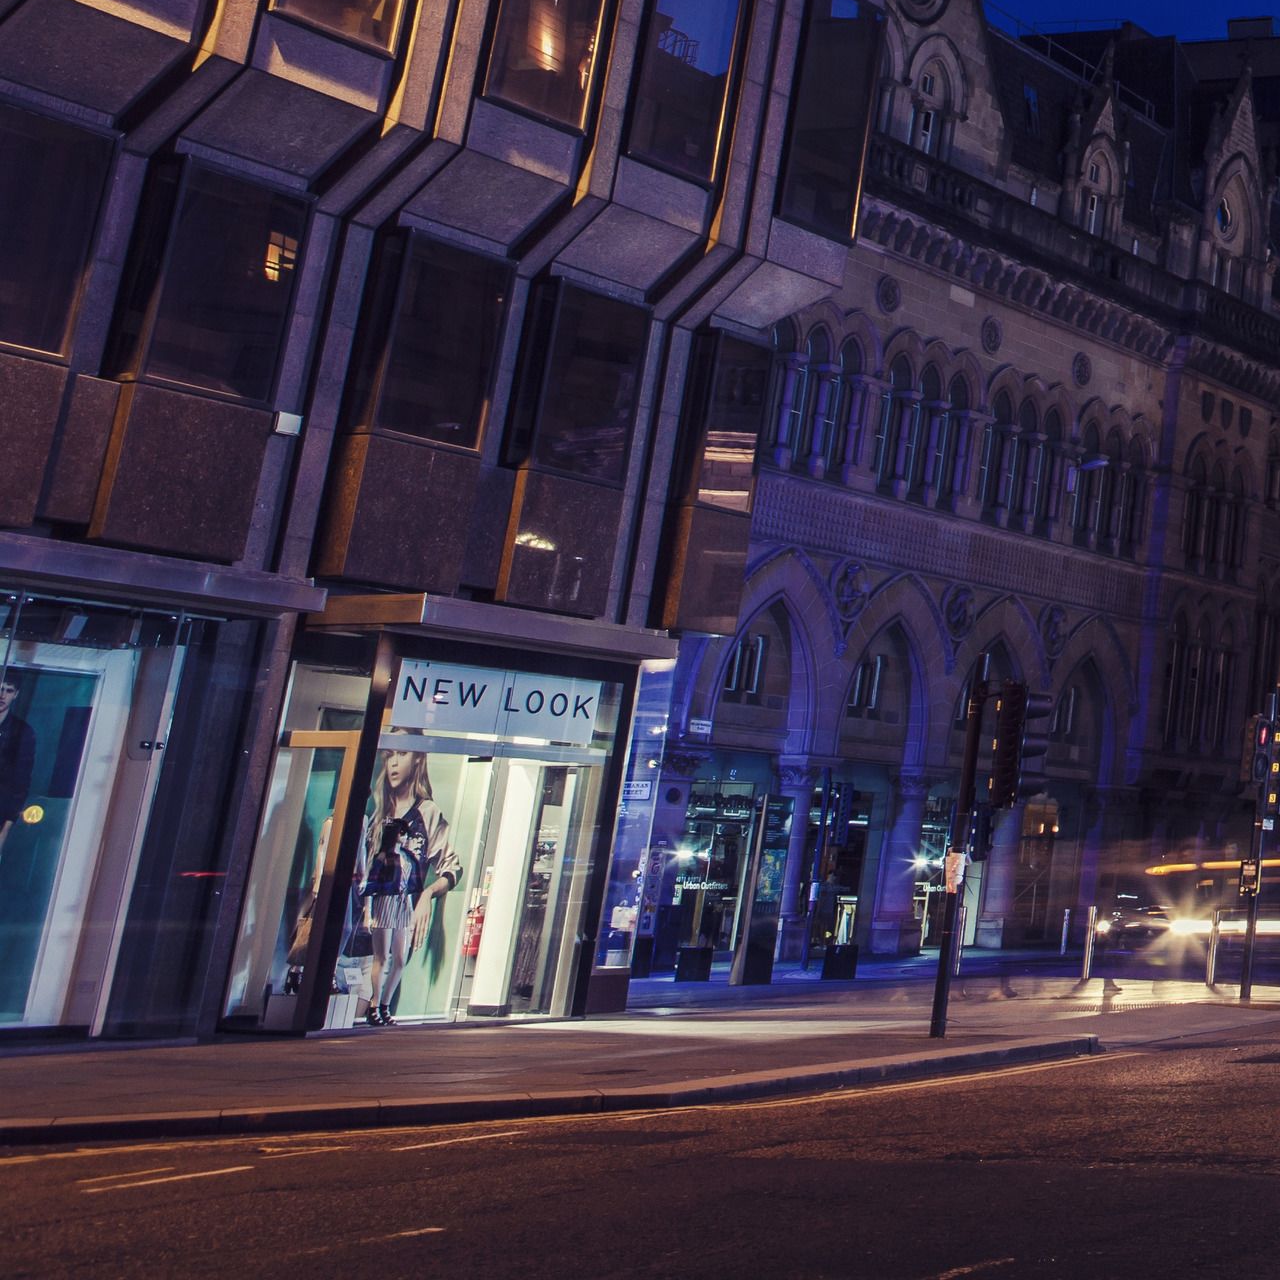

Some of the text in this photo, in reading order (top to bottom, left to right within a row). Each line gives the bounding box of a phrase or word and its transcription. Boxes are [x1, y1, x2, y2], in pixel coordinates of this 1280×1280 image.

[402, 675, 594, 719] NEW LOOK
[683, 880, 728, 890] Urban Outfitters
